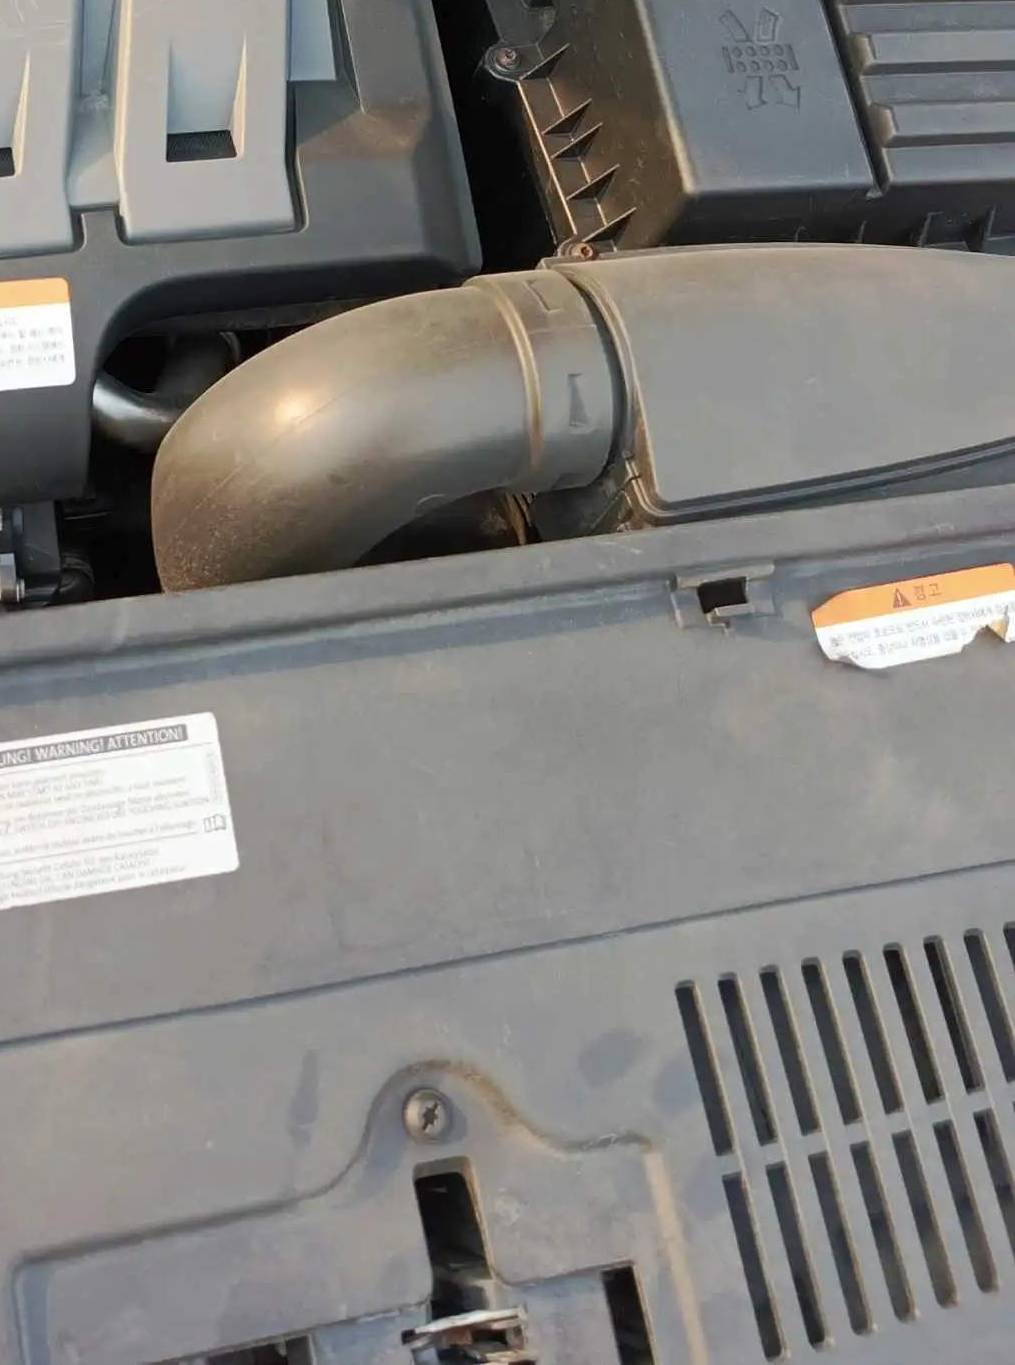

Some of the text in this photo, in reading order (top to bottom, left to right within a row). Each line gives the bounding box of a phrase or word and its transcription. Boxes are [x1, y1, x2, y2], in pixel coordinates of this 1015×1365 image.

[912, 582, 943, 601] 경고
[35, 738, 105, 761] WARNING!
[107, 726, 184, 750] ATTENTION!
